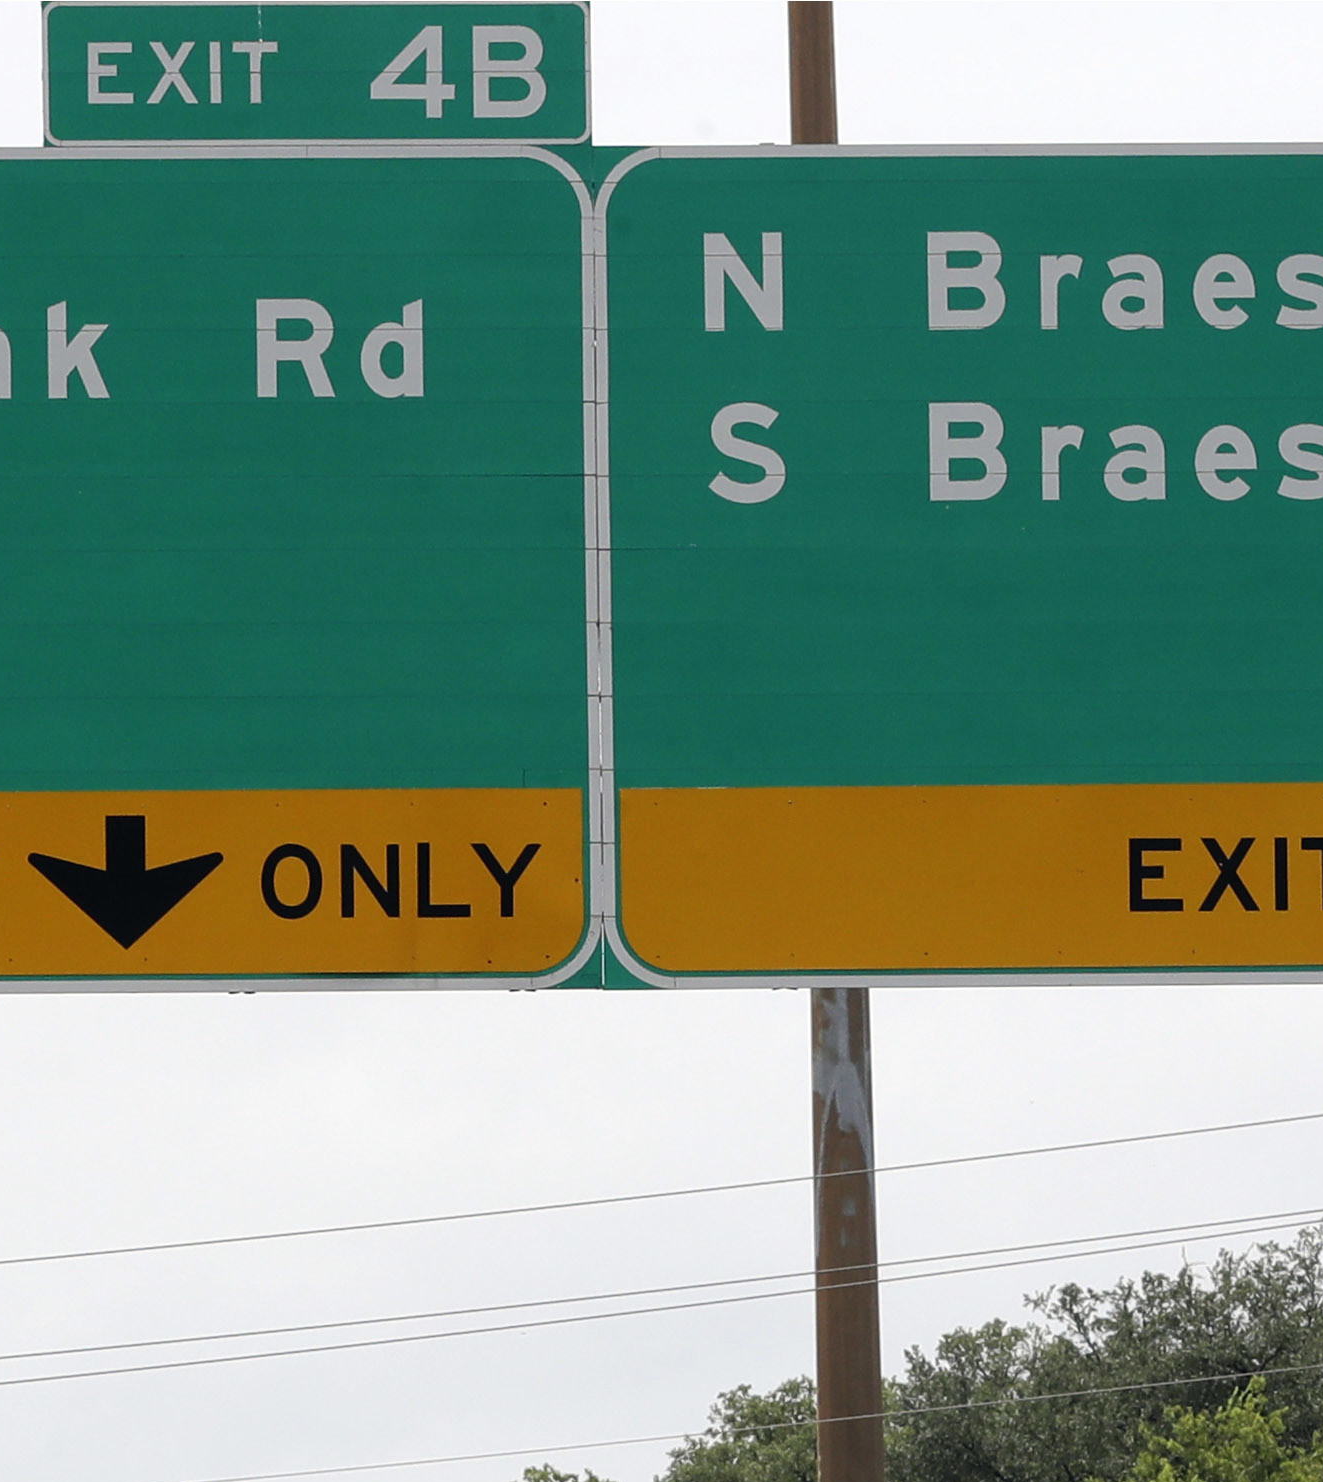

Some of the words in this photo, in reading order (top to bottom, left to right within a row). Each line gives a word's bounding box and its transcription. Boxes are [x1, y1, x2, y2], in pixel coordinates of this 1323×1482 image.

[87, 39, 279, 105] EXIT
[370, 24, 547, 119] 4B
[703, 231, 784, 332] N
[255, 298, 424, 399] Rd
[708, 401, 786, 504] S
[260, 841, 542, 920] ONLY
